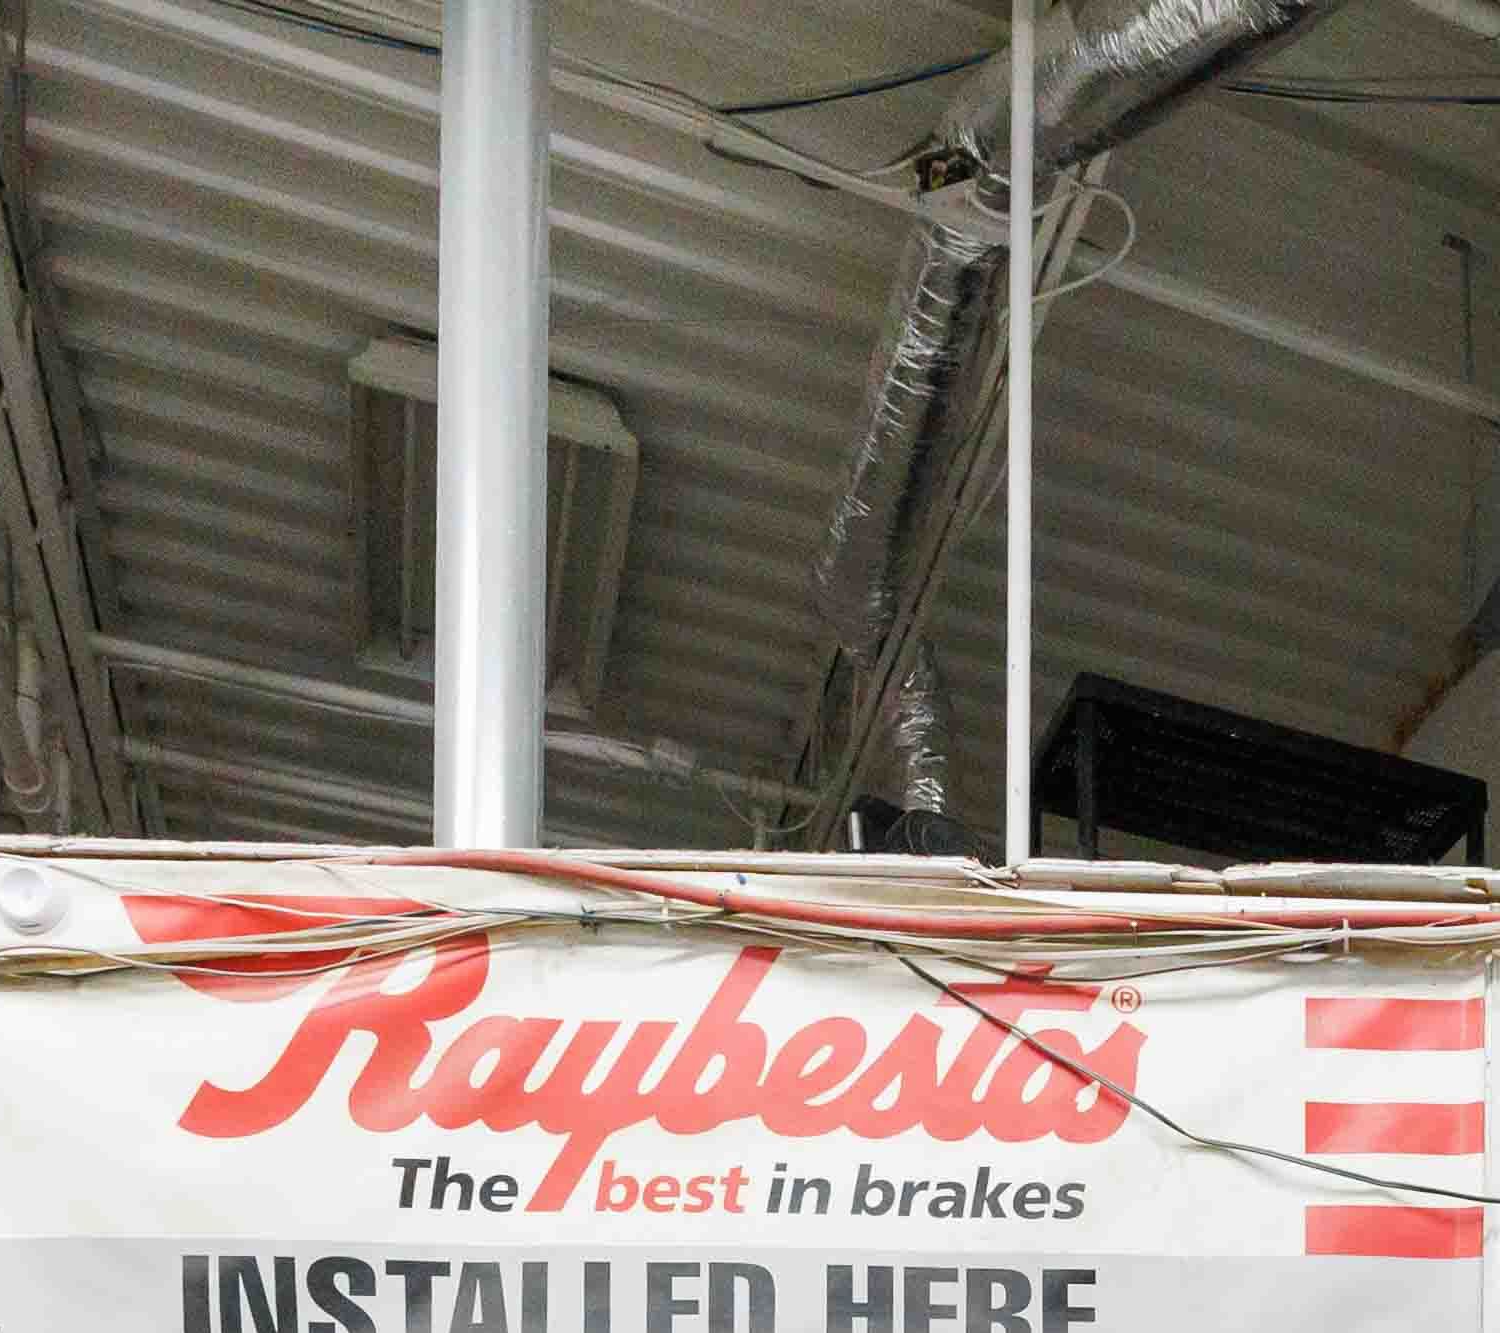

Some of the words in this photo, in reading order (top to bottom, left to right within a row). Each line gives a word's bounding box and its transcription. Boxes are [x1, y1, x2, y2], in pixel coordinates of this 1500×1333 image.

[176, 930, 1150, 1213] Raybestos
[392, 1156, 519, 1213] The
[594, 1159, 750, 1214] best
[766, 1162, 831, 1217] in
[850, 1165, 1086, 1221] brakes
